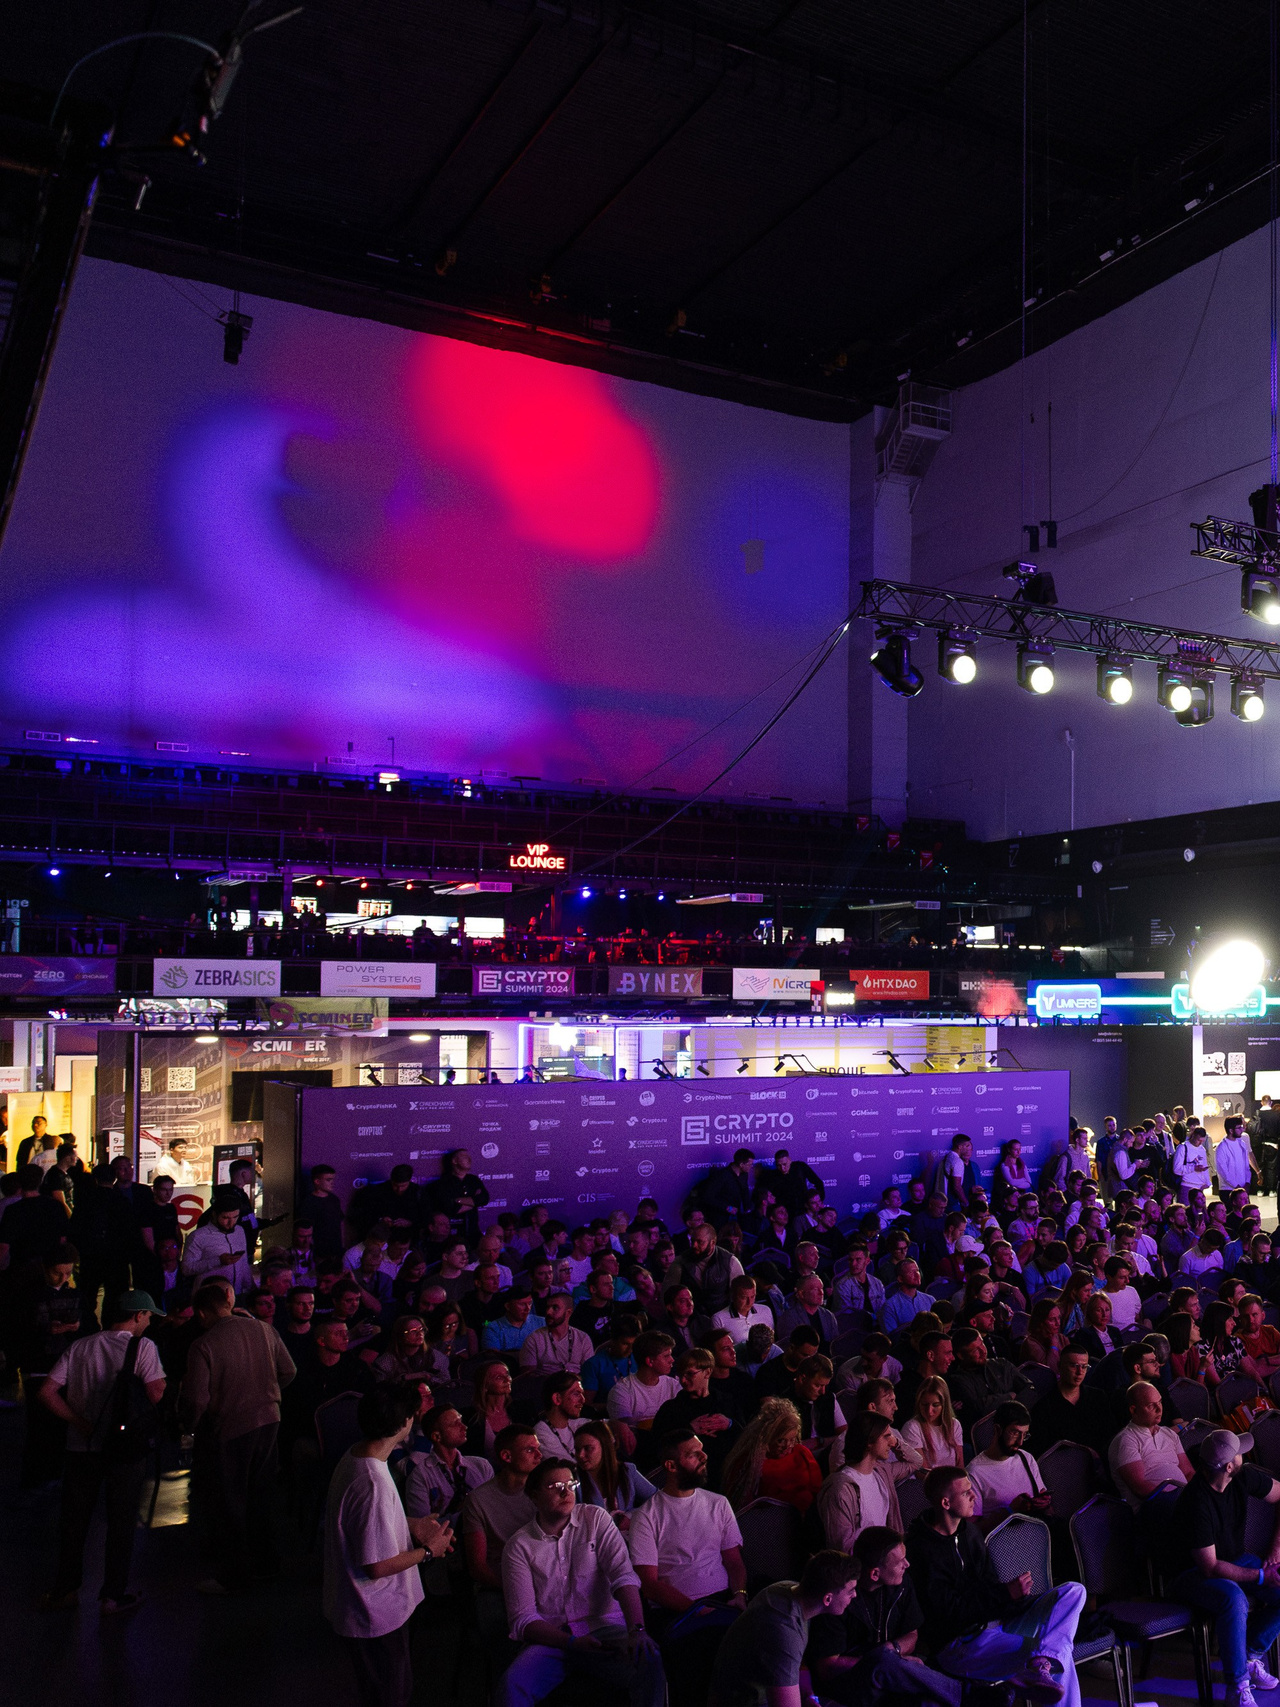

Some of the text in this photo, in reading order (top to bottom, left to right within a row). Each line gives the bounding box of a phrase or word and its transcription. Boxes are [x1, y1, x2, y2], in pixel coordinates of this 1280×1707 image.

[526, 843, 549, 856] VIP
[509, 855, 565, 869] LOUNGE
[34, 970, 65, 979] ZERO
[336, 965, 385, 974] POWER
[194, 969, 276, 987] ZEBRASICS
[361, 975, 422, 984] SYSTEMS
[504, 970, 569, 983] CRYPTO
[505, 984, 569, 993] SUMMIT 2024
[872, 979, 917, 989] HTX DAO
[1056, 998, 1098, 1009] UMINERS
[713, 1112, 794, 1130] CRYPTO
[714, 1131, 793, 1144] SUMMIT 2024
